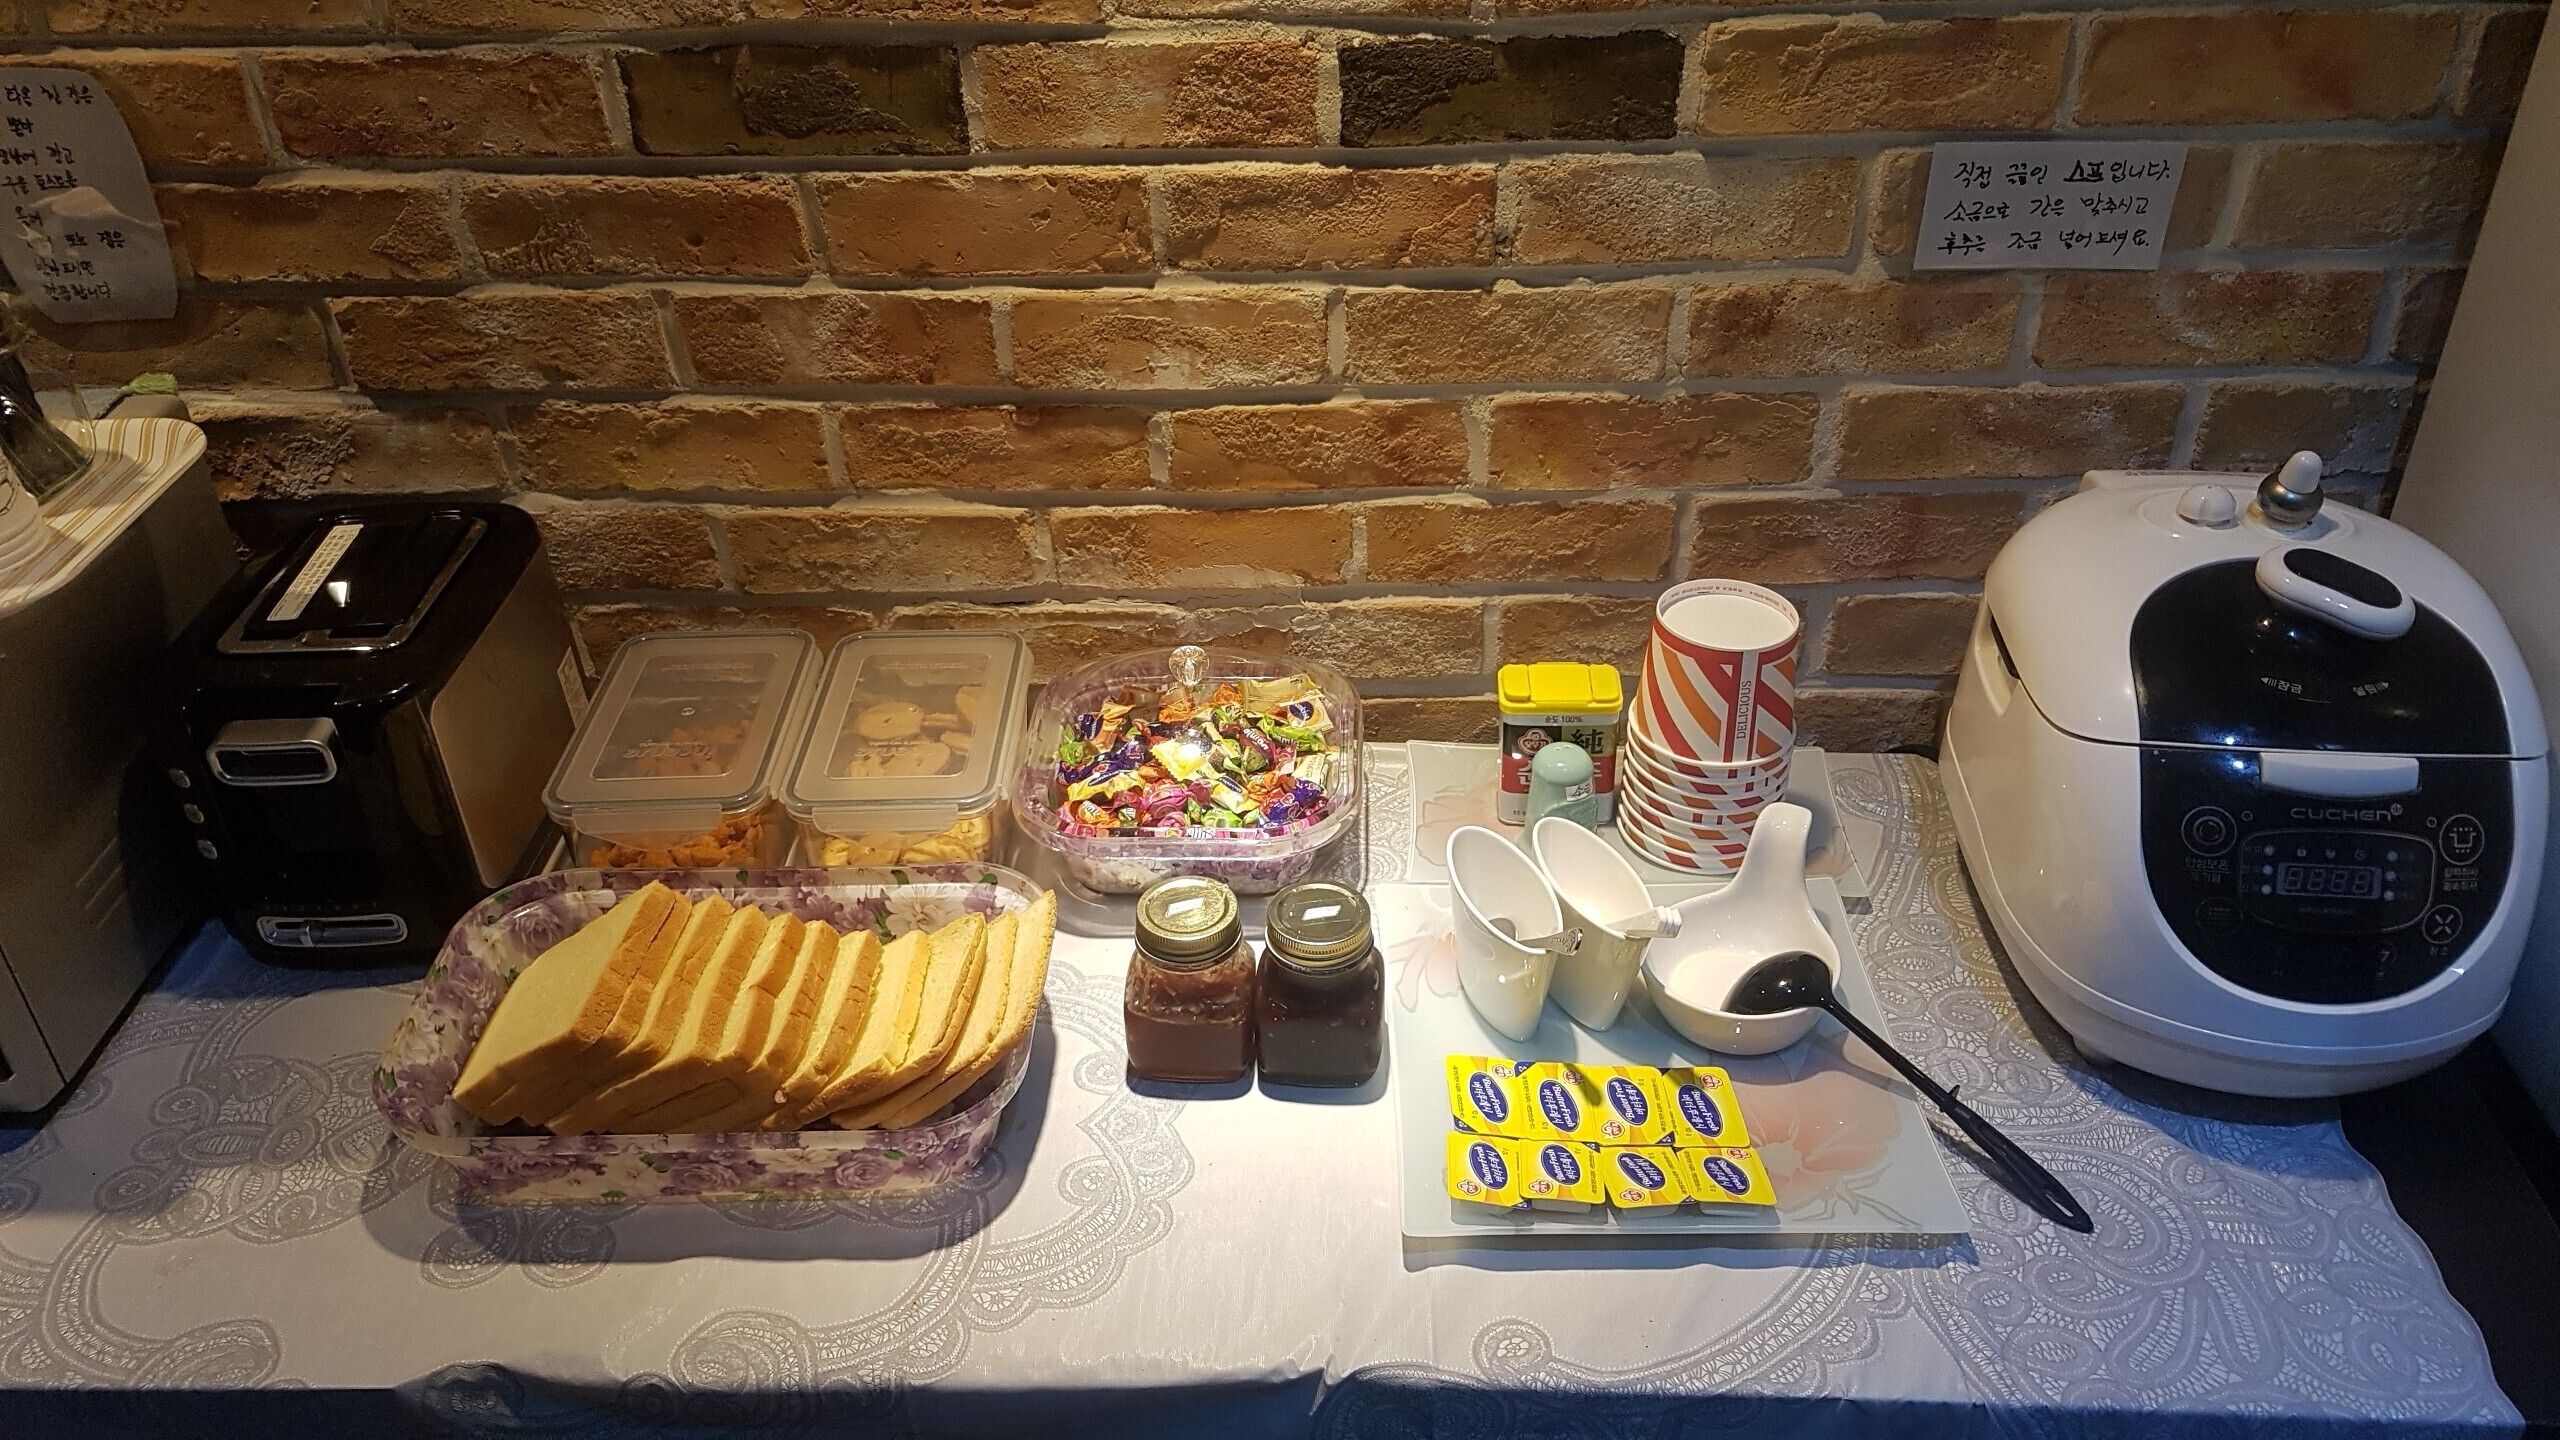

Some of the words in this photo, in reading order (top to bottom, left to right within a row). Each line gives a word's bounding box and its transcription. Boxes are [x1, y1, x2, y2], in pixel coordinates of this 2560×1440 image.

[1954, 161, 1992, 189] 직접
[2005, 162, 2048, 186] 끓인
[1944, 200, 2011, 222] 소금으로
[1938, 231, 1987, 256] 후추는
[2007, 231, 2043, 250] 조금
[2278, 680, 2303, 695] 잠금
[1561, 715, 1583, 724] 100%
[1737, 680, 1752, 740] DELICIOUS
[2290, 807, 2393, 822] CUCHEN
